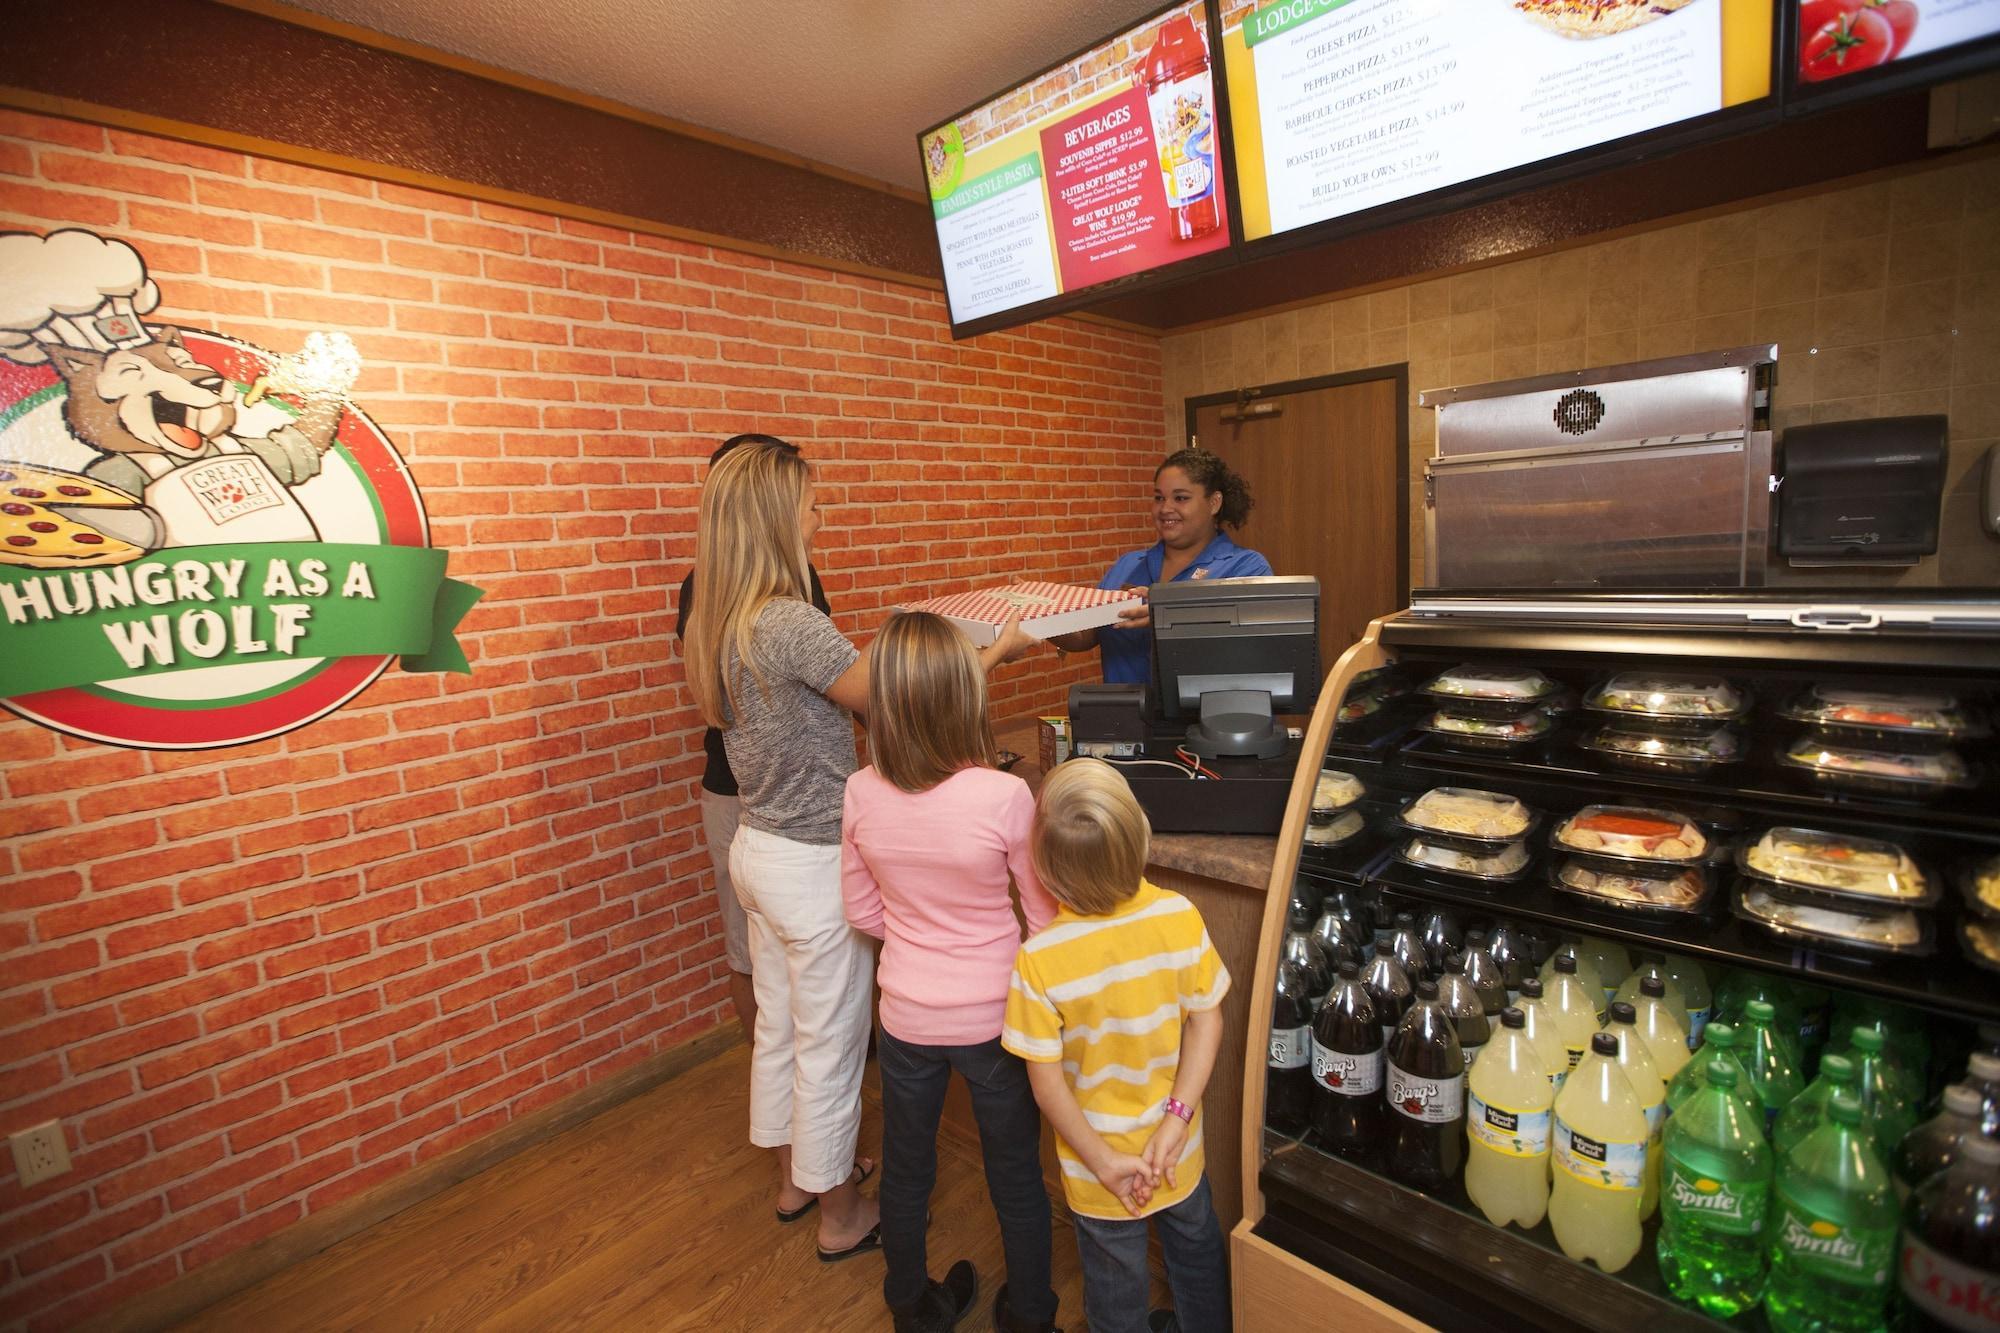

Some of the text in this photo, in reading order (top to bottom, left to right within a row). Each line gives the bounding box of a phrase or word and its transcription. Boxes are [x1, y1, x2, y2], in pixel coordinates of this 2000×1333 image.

[1256, 0, 1331, 37] LODGE-
[1307, 36, 1344, 59] CHEESE
[1348, 24, 1375, 43] PIZZA
[1304, 34, 1429, 92] PEPPERONI PIZZA $13.99
[1539, 64, 1582, 83] Additional
[1584, 51, 1624, 68] Toppings
[1286, 60, 1456, 130] BARBEQUE CHICKEN PIZZA $13.99
[1537, 101, 1580, 118] Additional
[1583, 88, 1621, 105] Toppings
[1064, 105, 1131, 148] BEVERAGES
[1287, 102, 1464, 168] ROASTED VEGETABLE PIZZA $14.99
[1060, 126, 1143, 167] SOUVENIR SIPPER $12.99
[1004, 161, 1035, 185] PASTA
[1086, 176, 1103, 190] SOFT
[1105, 167, 1126, 182] DRINK
[1129, 159, 1147, 173] $3.99
[1312, 150, 1439, 197] BUILD YOUR OWN $12.99
[1073, 212, 1093, 226] GREAT
[1094, 205, 1113, 218] WOLF
[1089, 210, 1136, 231] WINE $19.99
[192, 463, 252, 488] GREAT
[218, 497, 273, 518] LODGE
[0, 558, 376, 625] HUNGRY AS A
[102, 603, 313, 670] WOLF
[1392, 1082, 1440, 1107] Barq's
[1487, 1108, 1516, 1124] Minute
[1573, 1135, 1604, 1153] Minute
[1671, 1182, 1735, 1211] Sprite
[1783, 1221, 1857, 1257] Sprite
